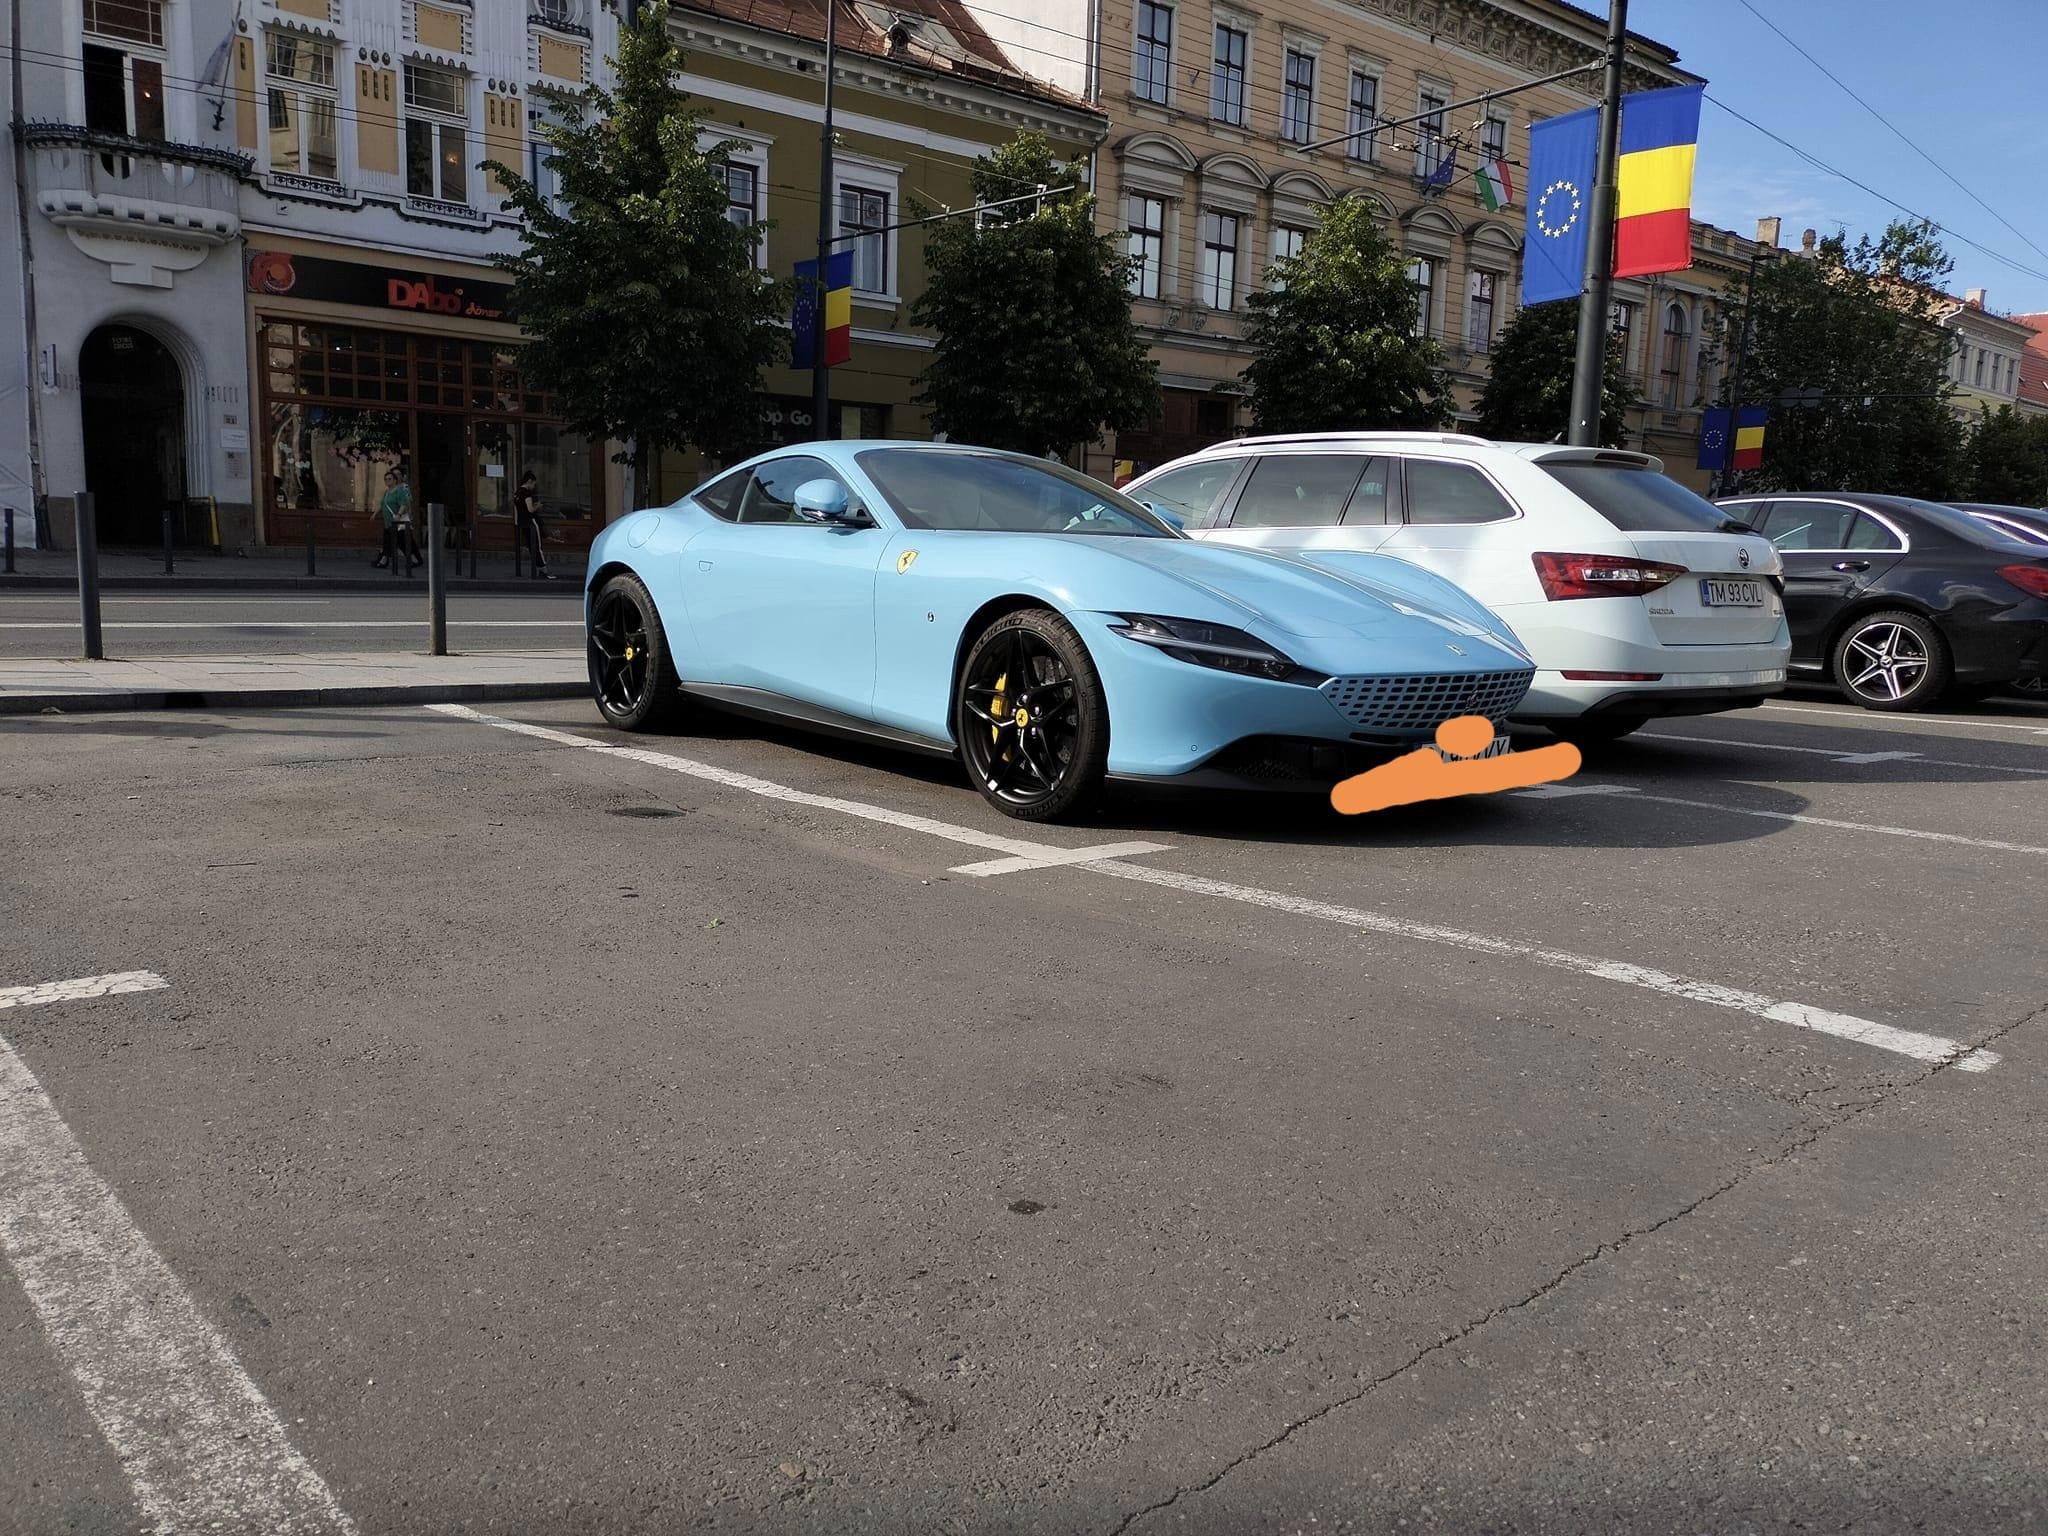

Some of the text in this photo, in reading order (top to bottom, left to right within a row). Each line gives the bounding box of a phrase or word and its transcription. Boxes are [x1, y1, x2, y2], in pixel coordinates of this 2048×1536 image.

[760, 409, 783, 426] op
[790, 409, 813, 426] Go
[1708, 582, 1762, 603] TM 93 CVL
